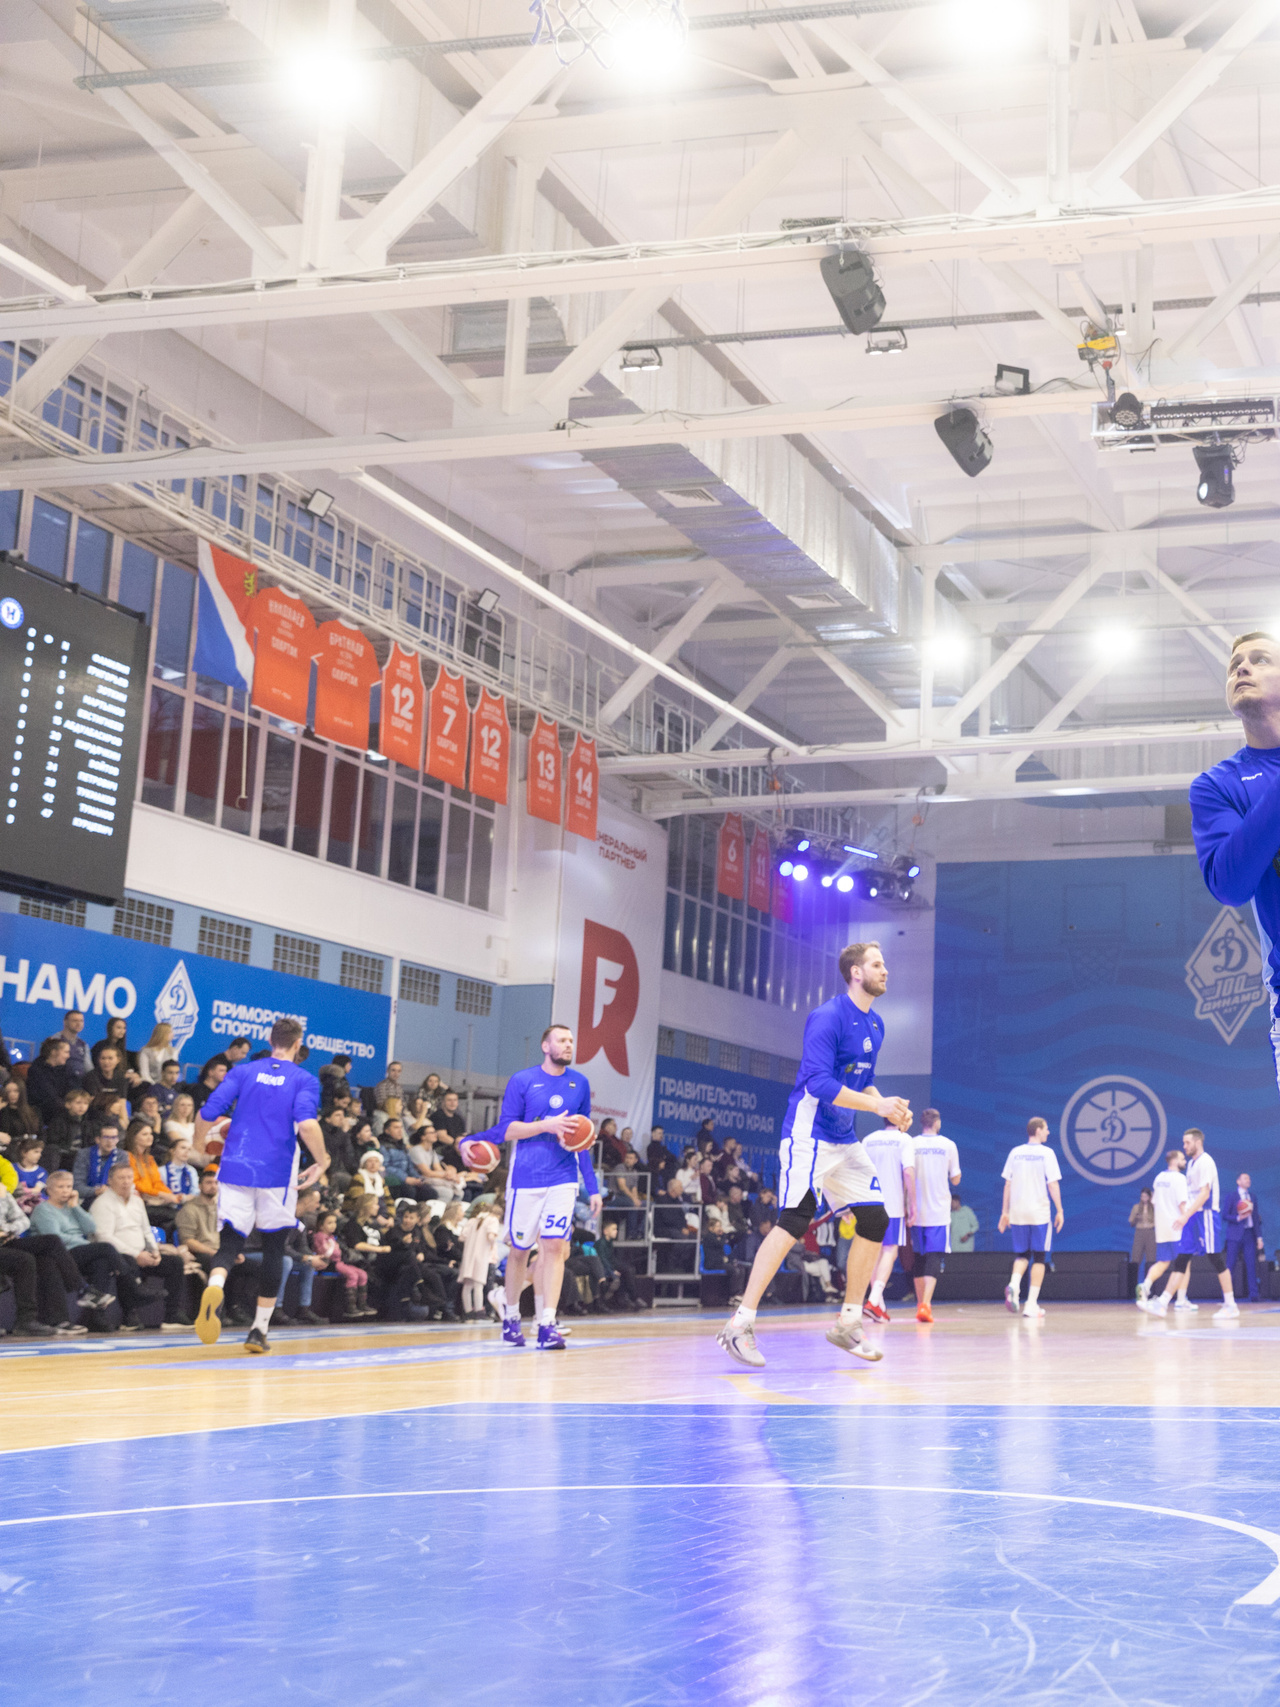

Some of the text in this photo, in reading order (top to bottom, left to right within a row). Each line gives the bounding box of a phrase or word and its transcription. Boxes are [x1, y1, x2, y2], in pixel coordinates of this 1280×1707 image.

[391, 683, 415, 720] 12
[443, 705, 456, 736] 7
[481, 725, 502, 759] 12
[537, 750, 555, 780] 13
[575, 767, 593, 798] 14
[597, 831, 648, 862] НЕРАЛЬНЫЙ
[598, 846, 637, 870] ПАРТНЕР
[727, 839, 737, 862] 6
[306, 1033, 376, 1059] ОБЩЕСТВО
[659, 1077, 757, 1110] ПРАВИТЕЛЬСТВО
[658, 1100, 774, 1133] ПРИМОРСКОГО КРАЯ
[545, 1215, 568, 1230] 54
